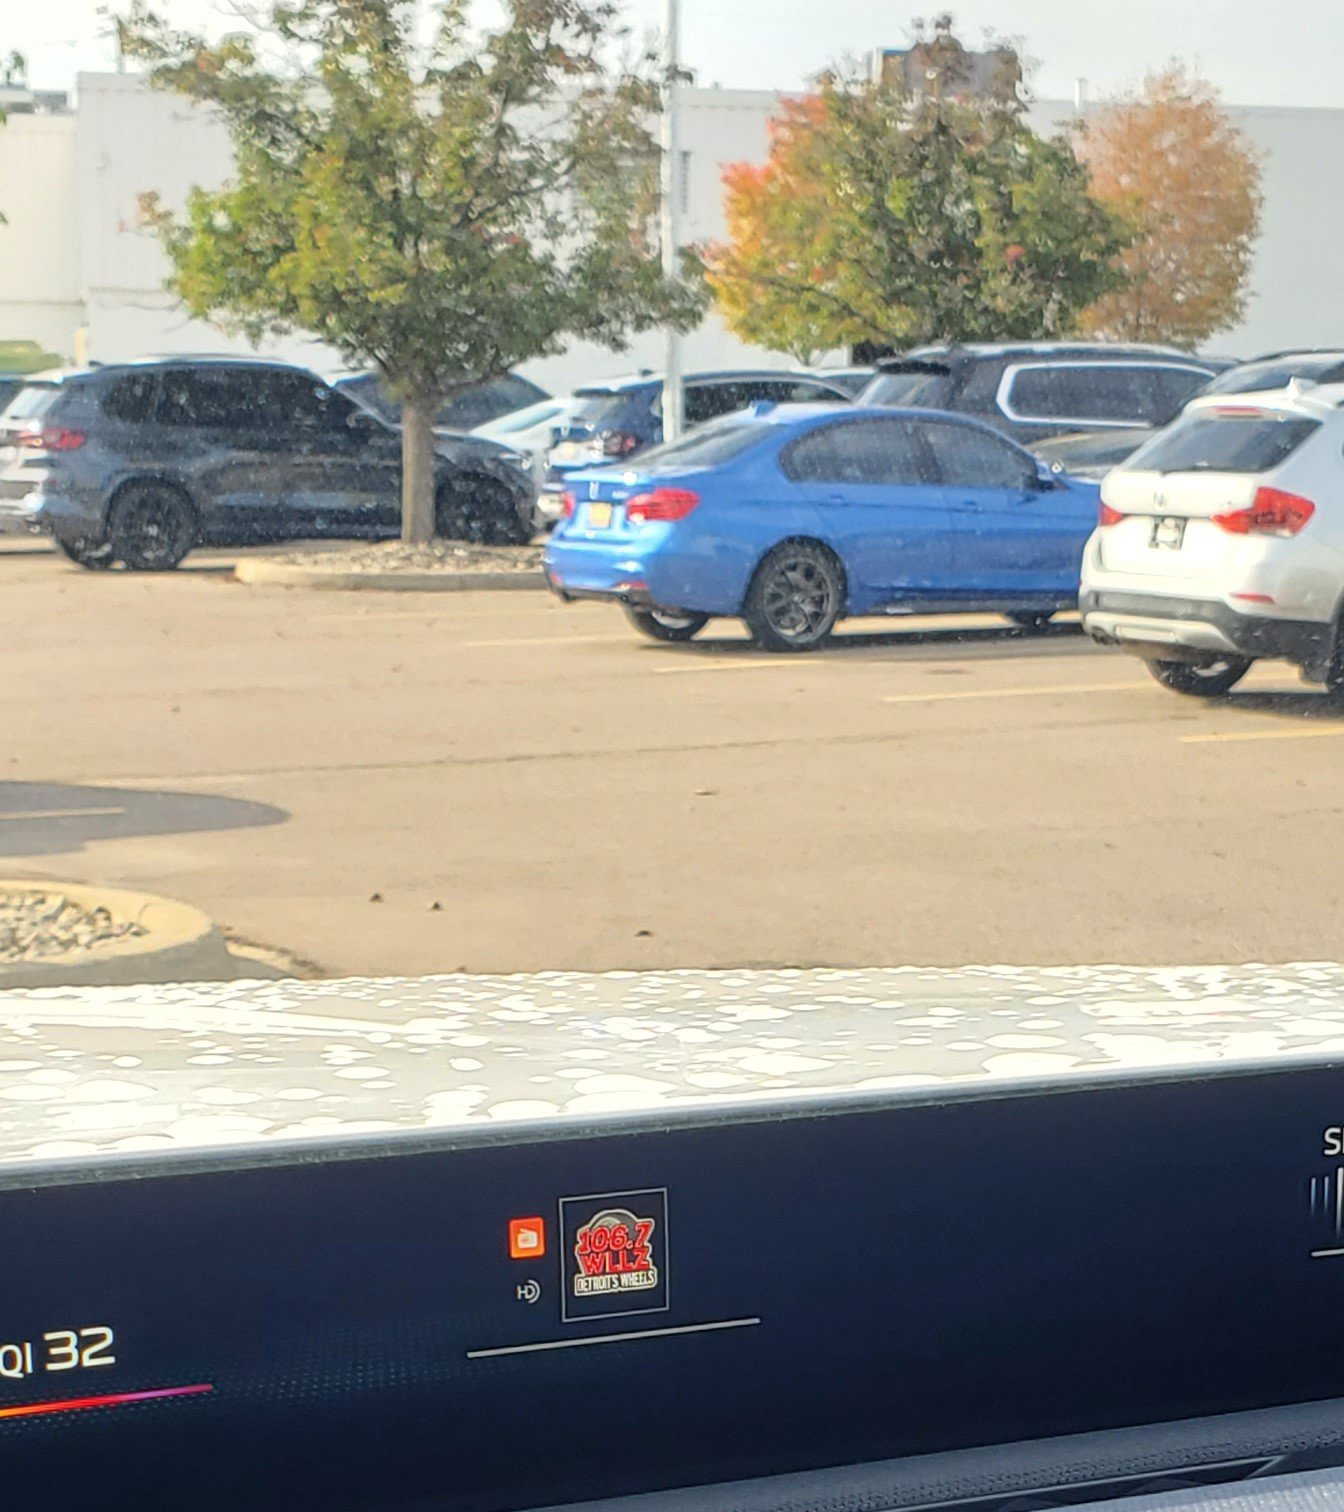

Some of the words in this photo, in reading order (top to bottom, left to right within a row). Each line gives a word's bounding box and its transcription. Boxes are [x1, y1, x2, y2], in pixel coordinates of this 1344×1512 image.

[578, 1221, 652, 1254] 106.7
[580, 1247, 651, 1275] WLLZ
[619, 1269, 655, 1288] WHEELS
[42, 1325, 117, 1372] 32
